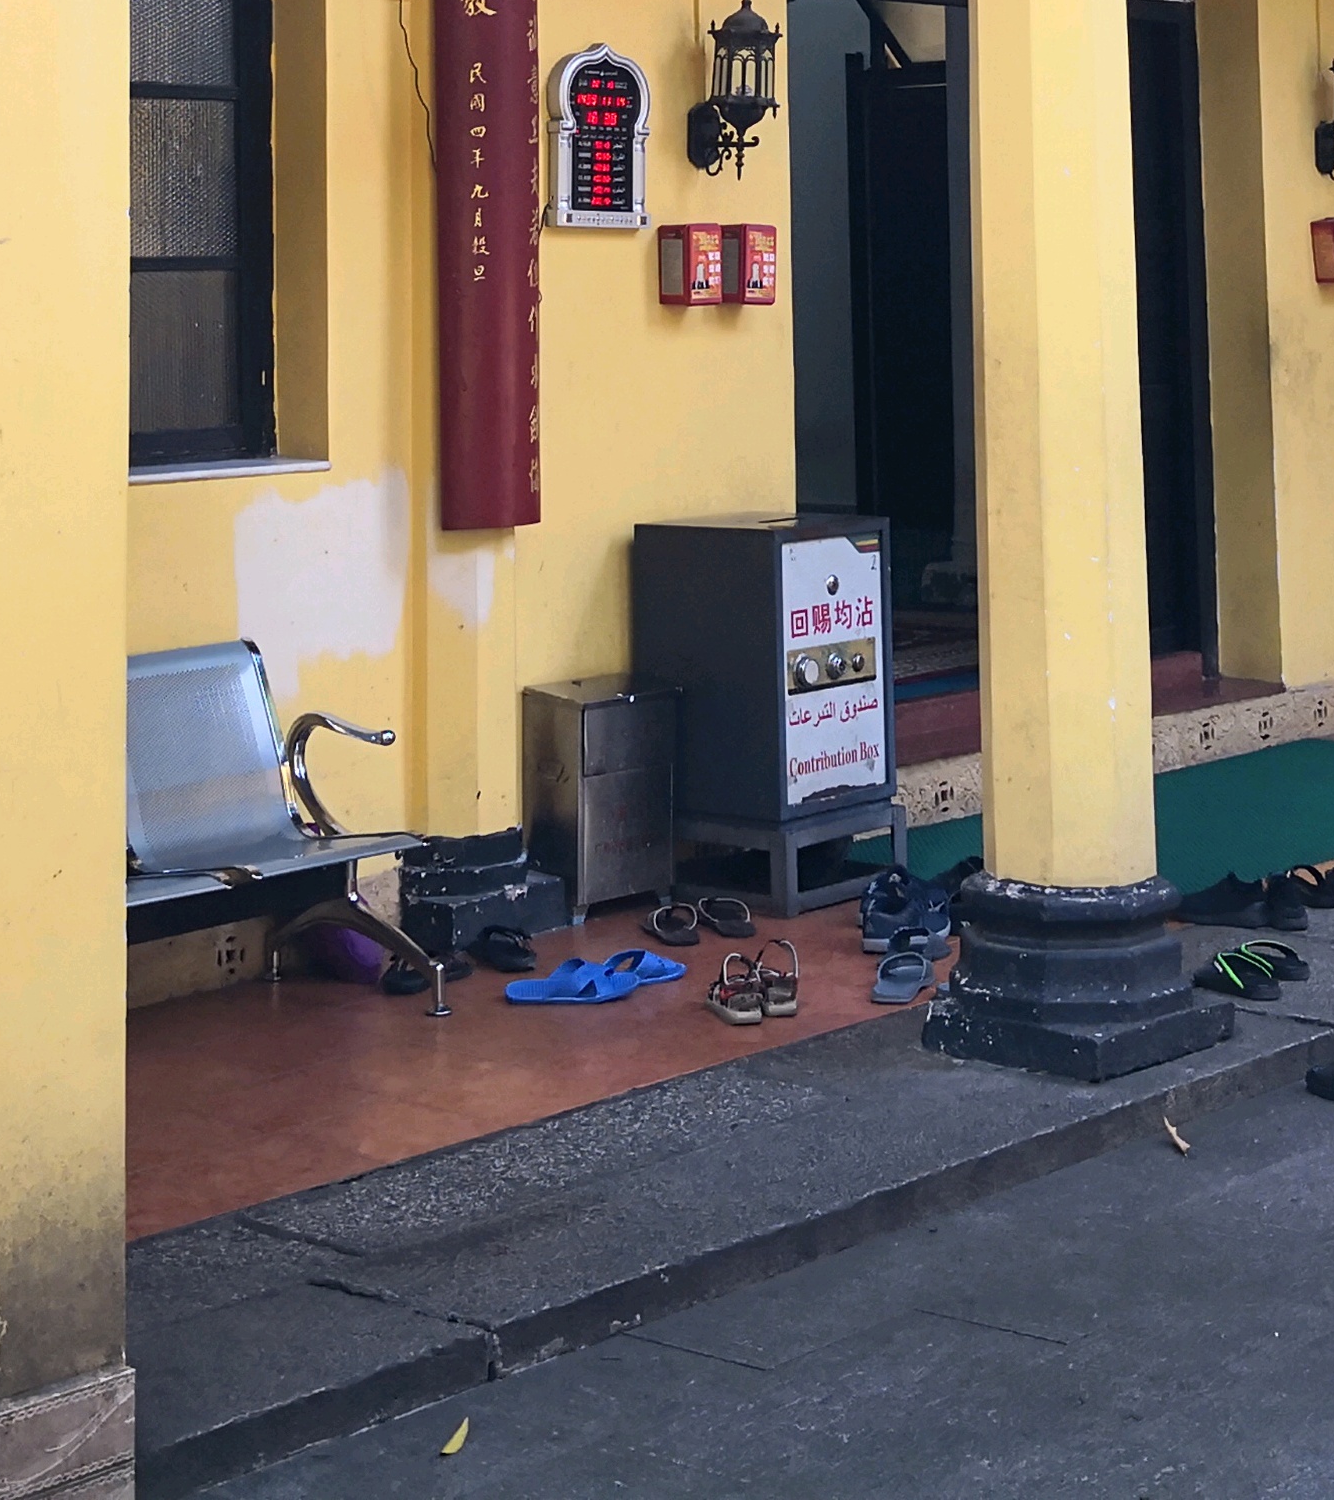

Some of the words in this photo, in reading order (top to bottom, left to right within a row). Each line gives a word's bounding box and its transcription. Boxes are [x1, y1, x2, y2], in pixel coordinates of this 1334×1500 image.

[790, 596, 873, 638] 回赐均沾
[840, 695, 879, 722] صندوق
[789, 746, 858, 778] Contribution
[859, 741, 880, 761] Box
